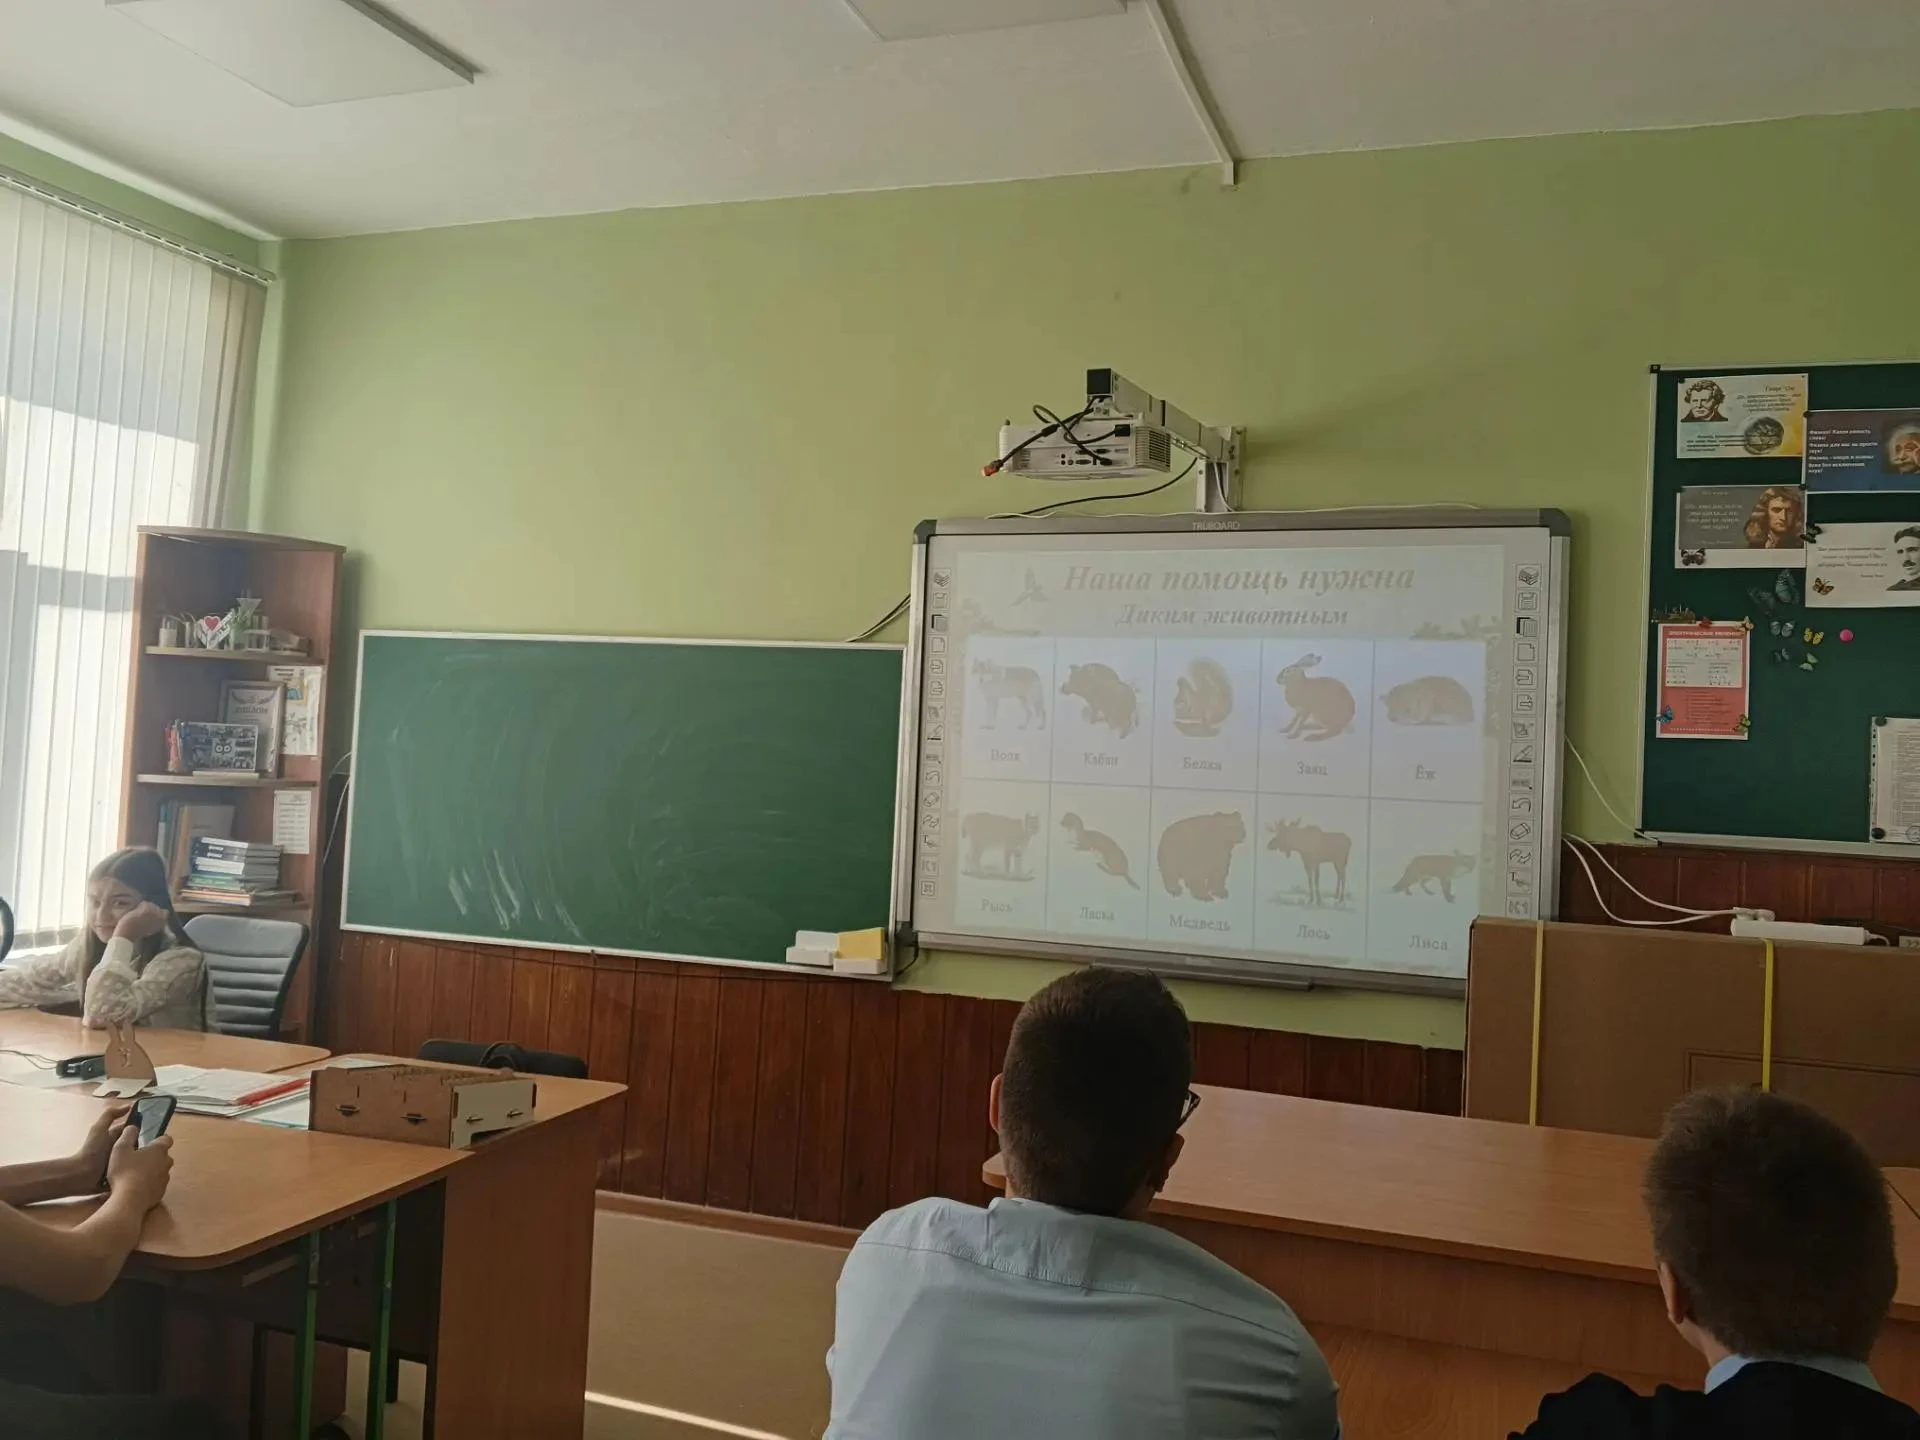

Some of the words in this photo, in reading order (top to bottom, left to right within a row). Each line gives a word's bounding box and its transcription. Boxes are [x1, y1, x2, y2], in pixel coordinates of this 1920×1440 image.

[1064, 566, 1152, 592] Наша
[1161, 569, 1288, 595] помощь
[1298, 569, 1415, 597] нужна
[1115, 604, 1196, 627] Диким
[1203, 609, 1349, 625] животным
[980, 899, 1013, 913] Рысь
[1169, 914, 1231, 932] Медведь
[1297, 925, 1331, 940] Лось
[1409, 935, 1448, 951] Лиса
